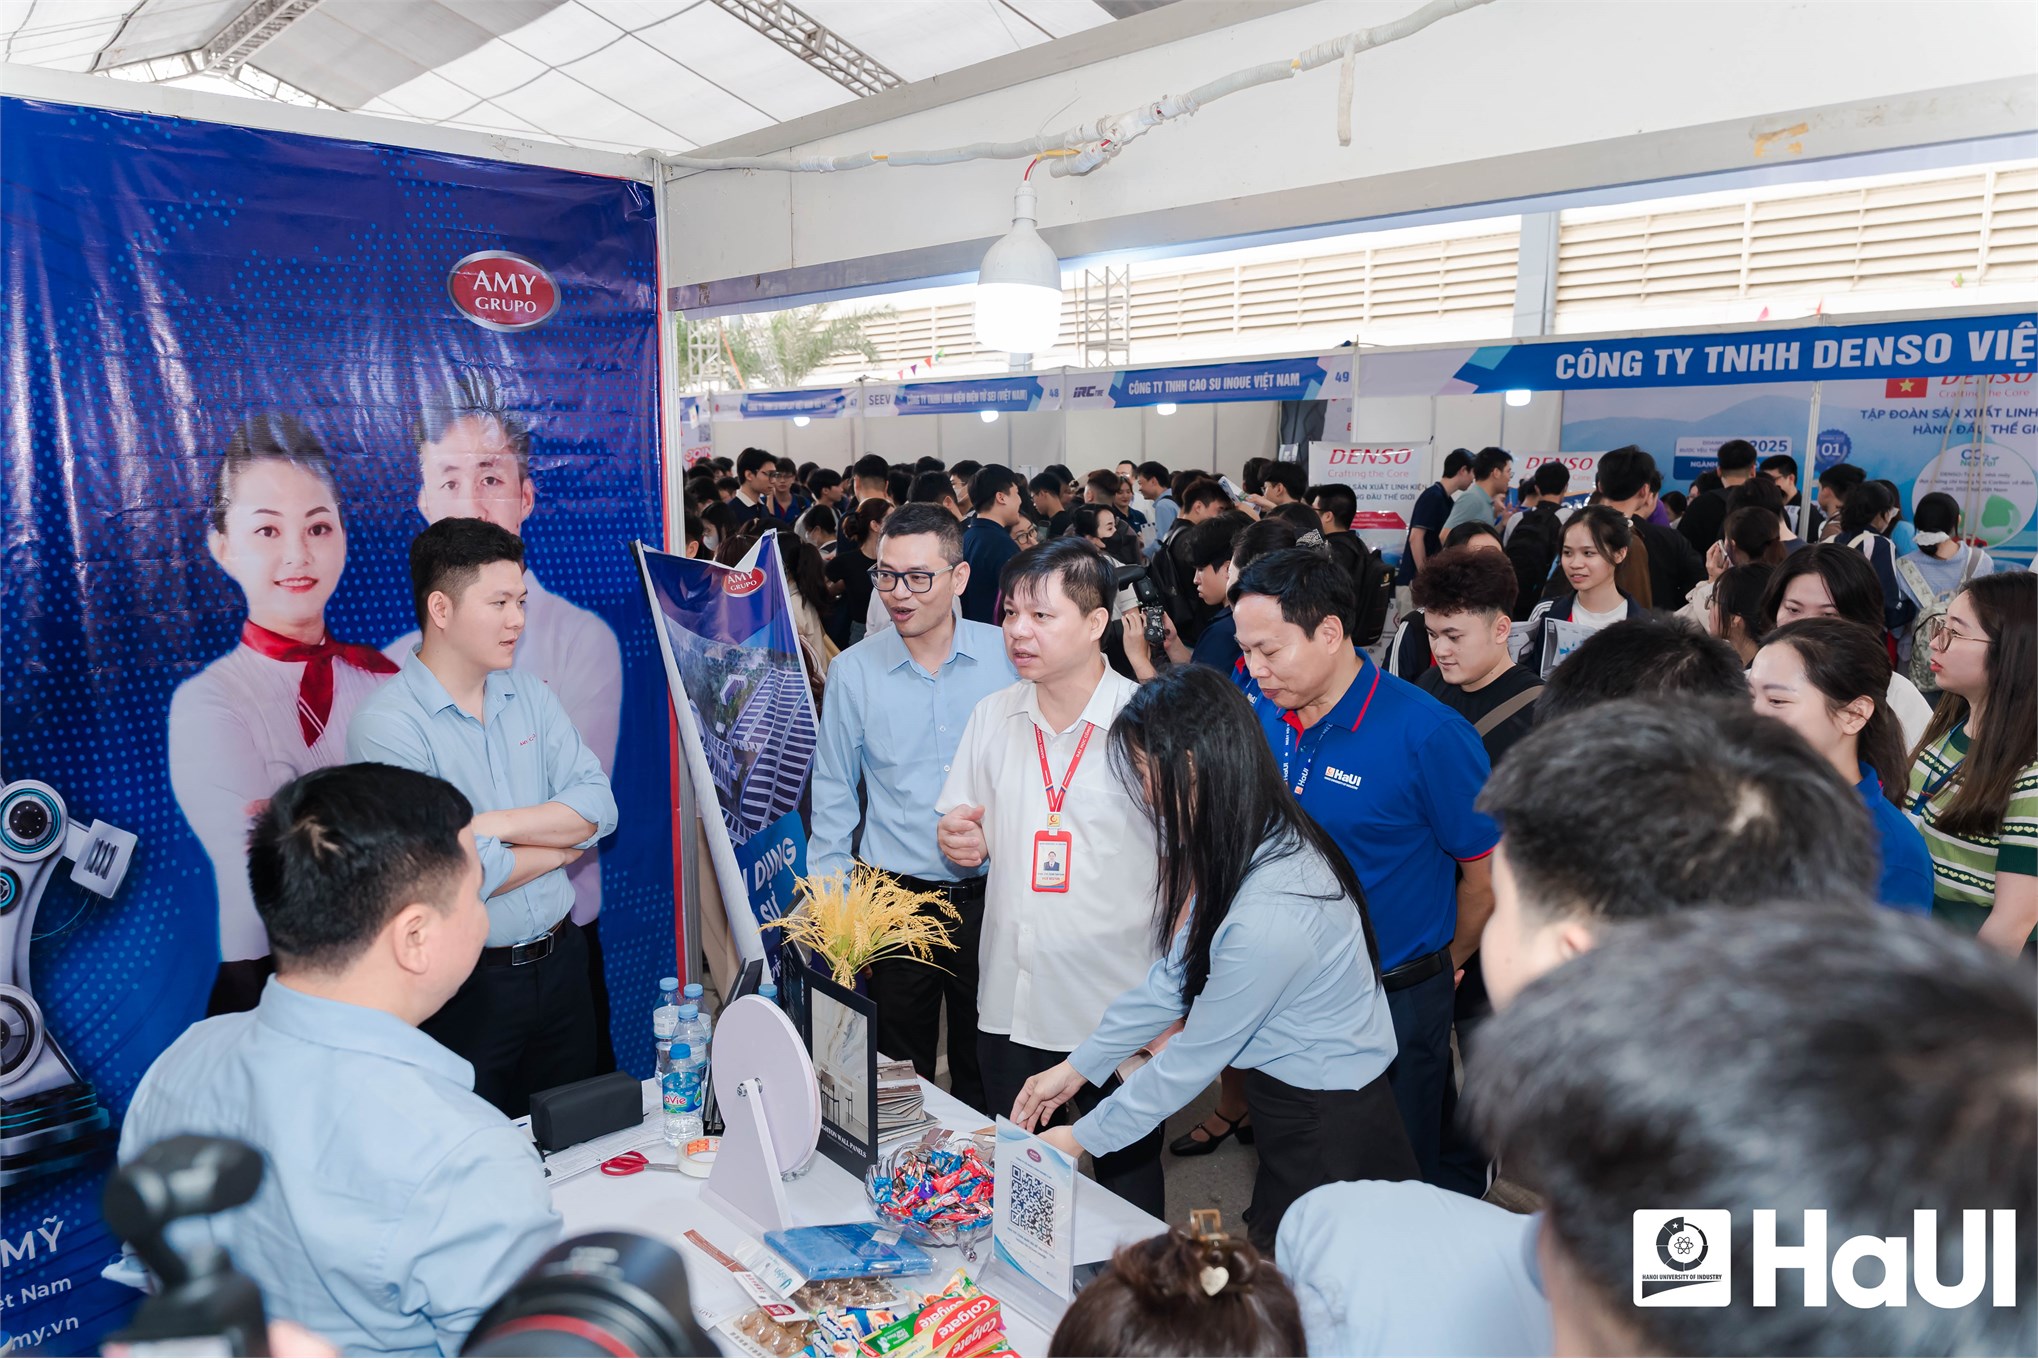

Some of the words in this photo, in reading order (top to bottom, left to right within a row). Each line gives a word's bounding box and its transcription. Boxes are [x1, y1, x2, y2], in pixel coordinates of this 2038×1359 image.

[473, 270, 536, 295] AMY
[475, 297, 537, 313] GRUPO
[1555, 347, 1643, 380] CÔNG
[1654, 347, 1694, 376] TY
[1704, 341, 1799, 373] TNHH
[1812, 332, 1953, 369] DENSO
[1129, 380, 1151, 395] CÔNG
[1153, 381, 1163, 393] TY
[1165, 380, 1187, 393] TNHH
[1189, 378, 1207, 391] CAO
[1209, 378, 1221, 391] SU
[1223, 376, 1251, 389] INOUE
[1254, 372, 1274, 391] VIỆT
[1276, 372, 1300, 387] NAM
[1335, 371, 1350, 383] 49
[869, 394, 891, 406] SEEV
[1860, 408, 1886, 422] TẬP
[1889, 407, 1928, 420] ĐOÀN
[1990, 421, 2018, 435] THẾ
[2022, 423, 2037, 435] GI
[1328, 449, 1413, 465] DENSO
[1821, 443, 1841, 457] 01
[1328, 469, 1367, 480] Crafting
[1368, 469, 1383, 478] the
[1386, 469, 1409, 478] Core
[727, 571, 754, 585] AMY
[730, 580, 757, 591] GRUPO
[1297, 767, 1310, 787] HaUI
[1334, 769, 1362, 787] HaUI
[754, 837, 797, 891] DỤNG
[21, 1277, 72, 1304] Nam
[938, 1299, 991, 1337] Colgate
[952, 1317, 997, 1354] Colgate
